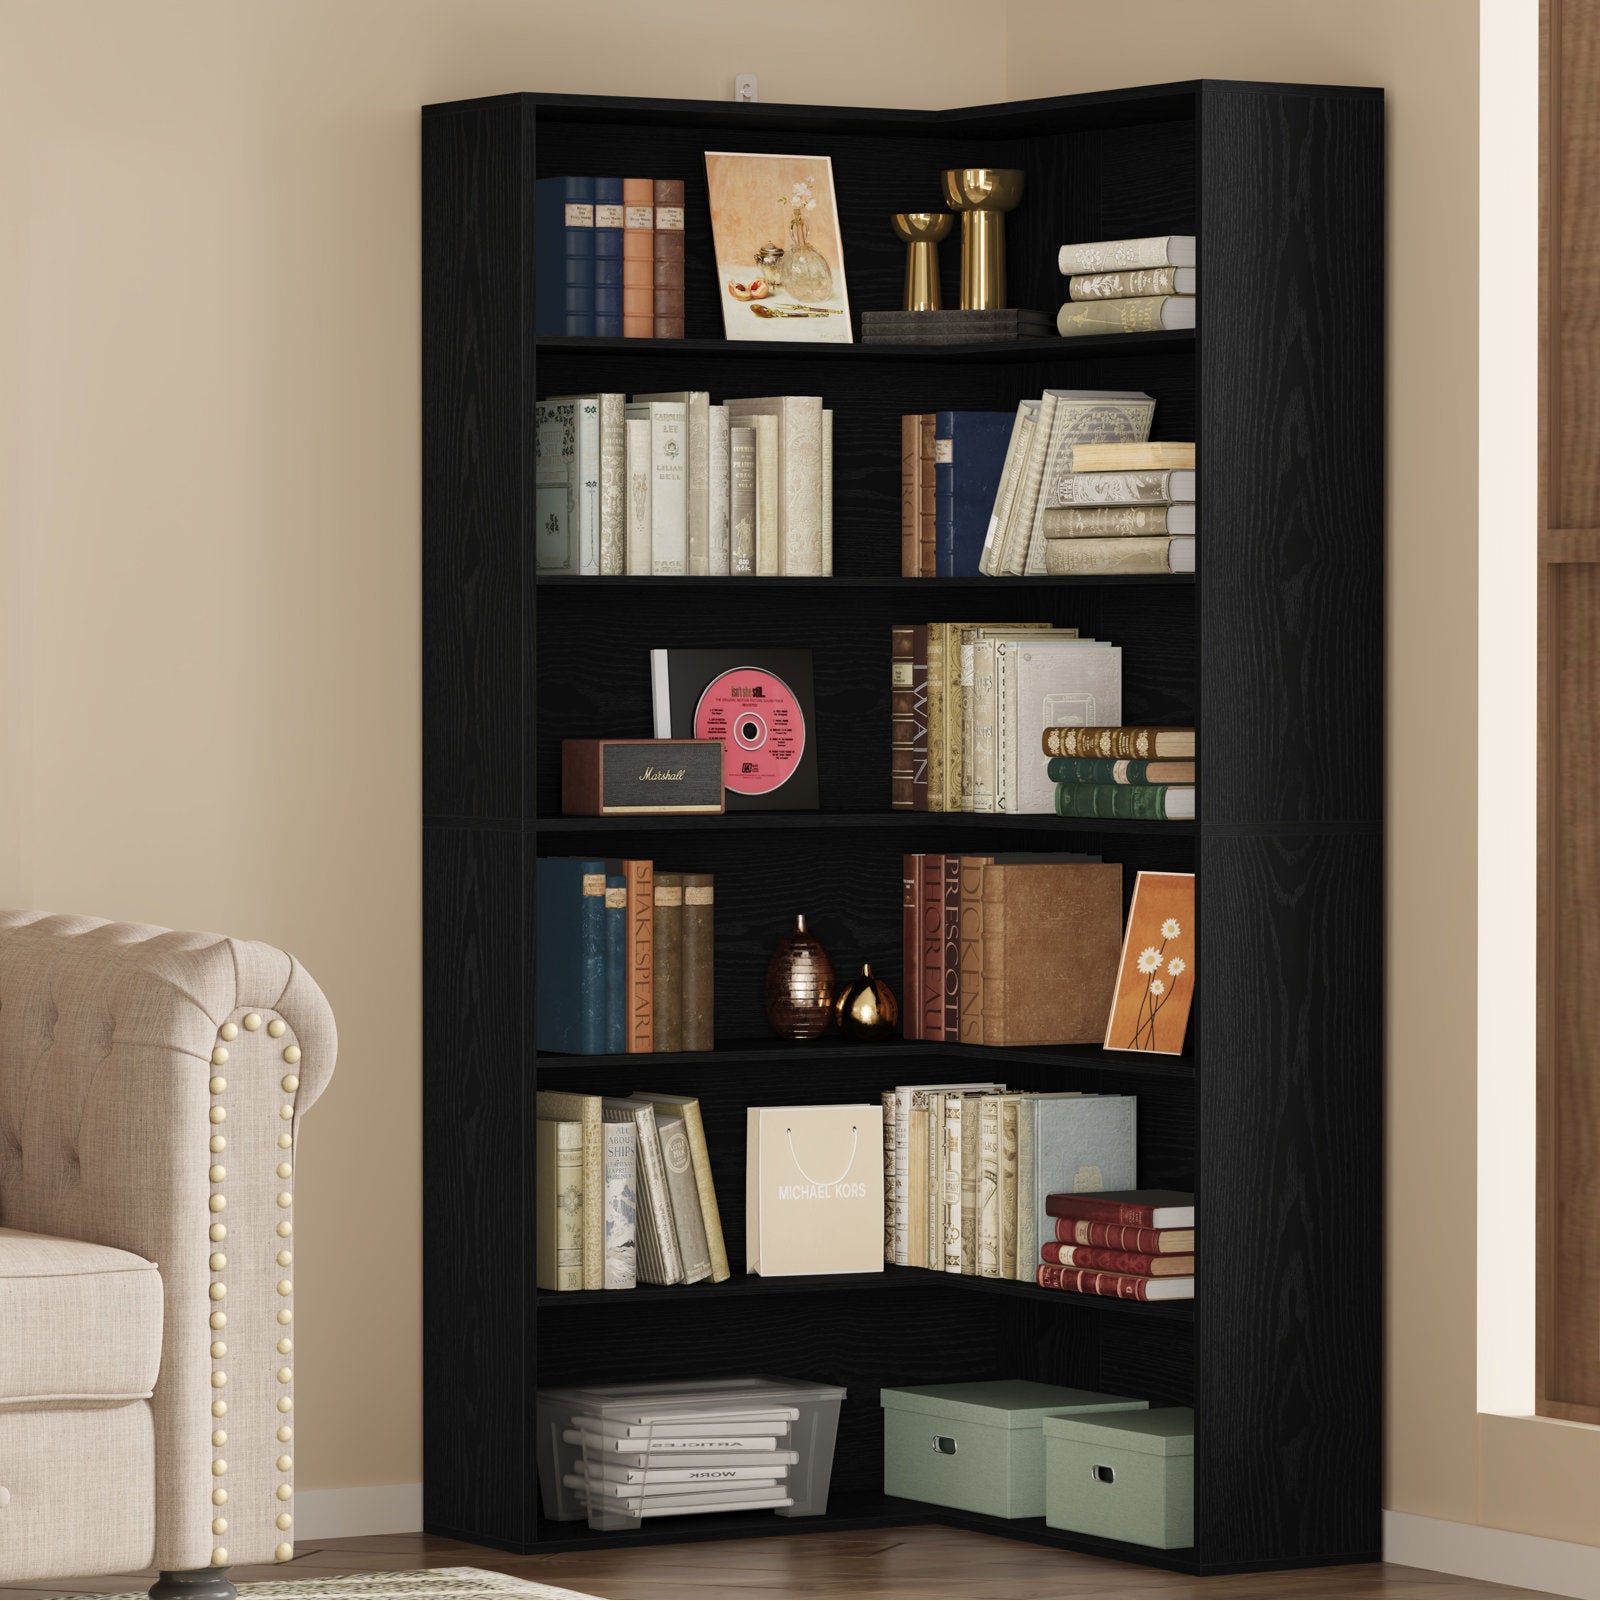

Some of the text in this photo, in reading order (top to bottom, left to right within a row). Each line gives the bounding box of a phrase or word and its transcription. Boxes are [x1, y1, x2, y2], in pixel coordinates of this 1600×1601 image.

[663, 425, 679, 433] LEE
[639, 766, 686, 782] Marshall
[635, 865, 651, 1049] SHAKESPEARE
[925, 863, 941, 1033] THOREAU
[945, 858, 959, 1041] PRESCOTT
[962, 865, 981, 1037] DICKENS
[608, 1136, 635, 1144] ABOUT
[608, 1146, 635, 1157] SHIPS
[779, 1182, 867, 1200] MICHAEL KORS
